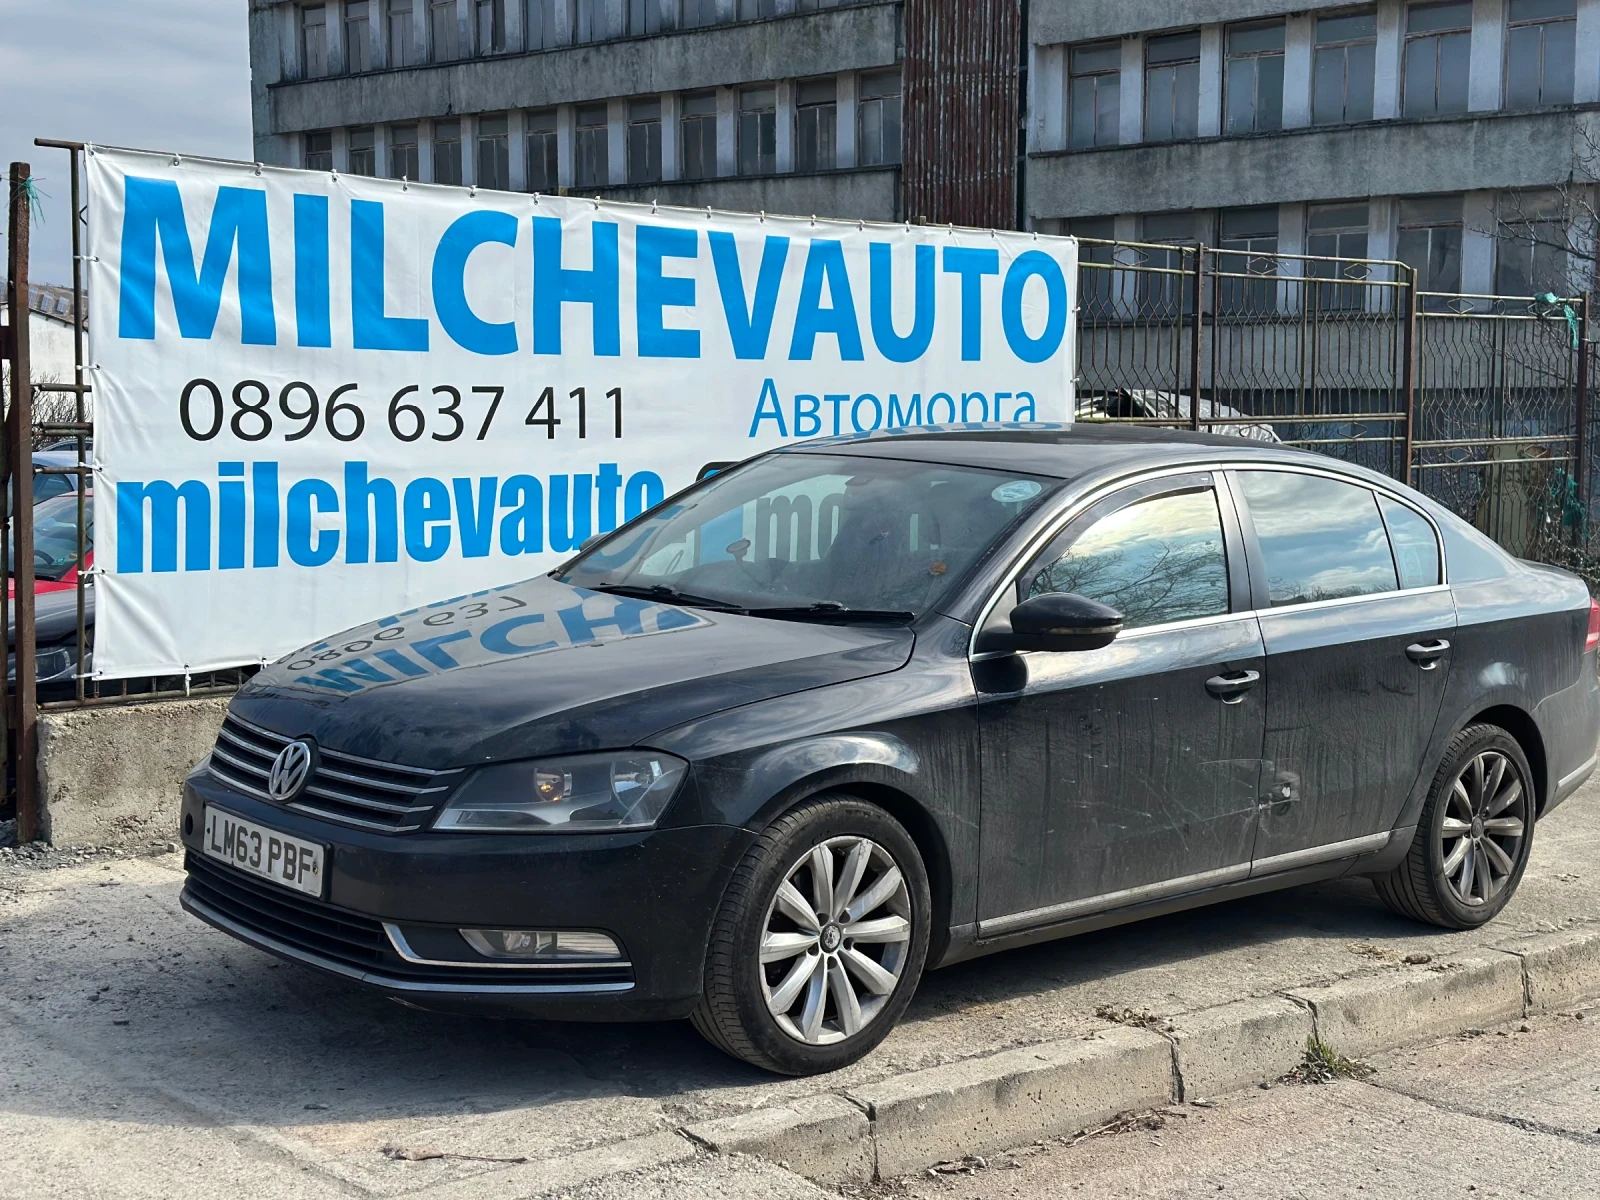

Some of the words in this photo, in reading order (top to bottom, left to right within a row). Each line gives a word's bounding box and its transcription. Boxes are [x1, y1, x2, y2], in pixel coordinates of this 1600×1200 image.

[119, 176, 1067, 363] MILCHEVAUTO
[180, 379, 364, 442] 0896
[388, 385, 504, 442] 637
[526, 387, 621, 440] 411
[211, 815, 262, 868] LM63
[267, 836, 314, 884] PBF
